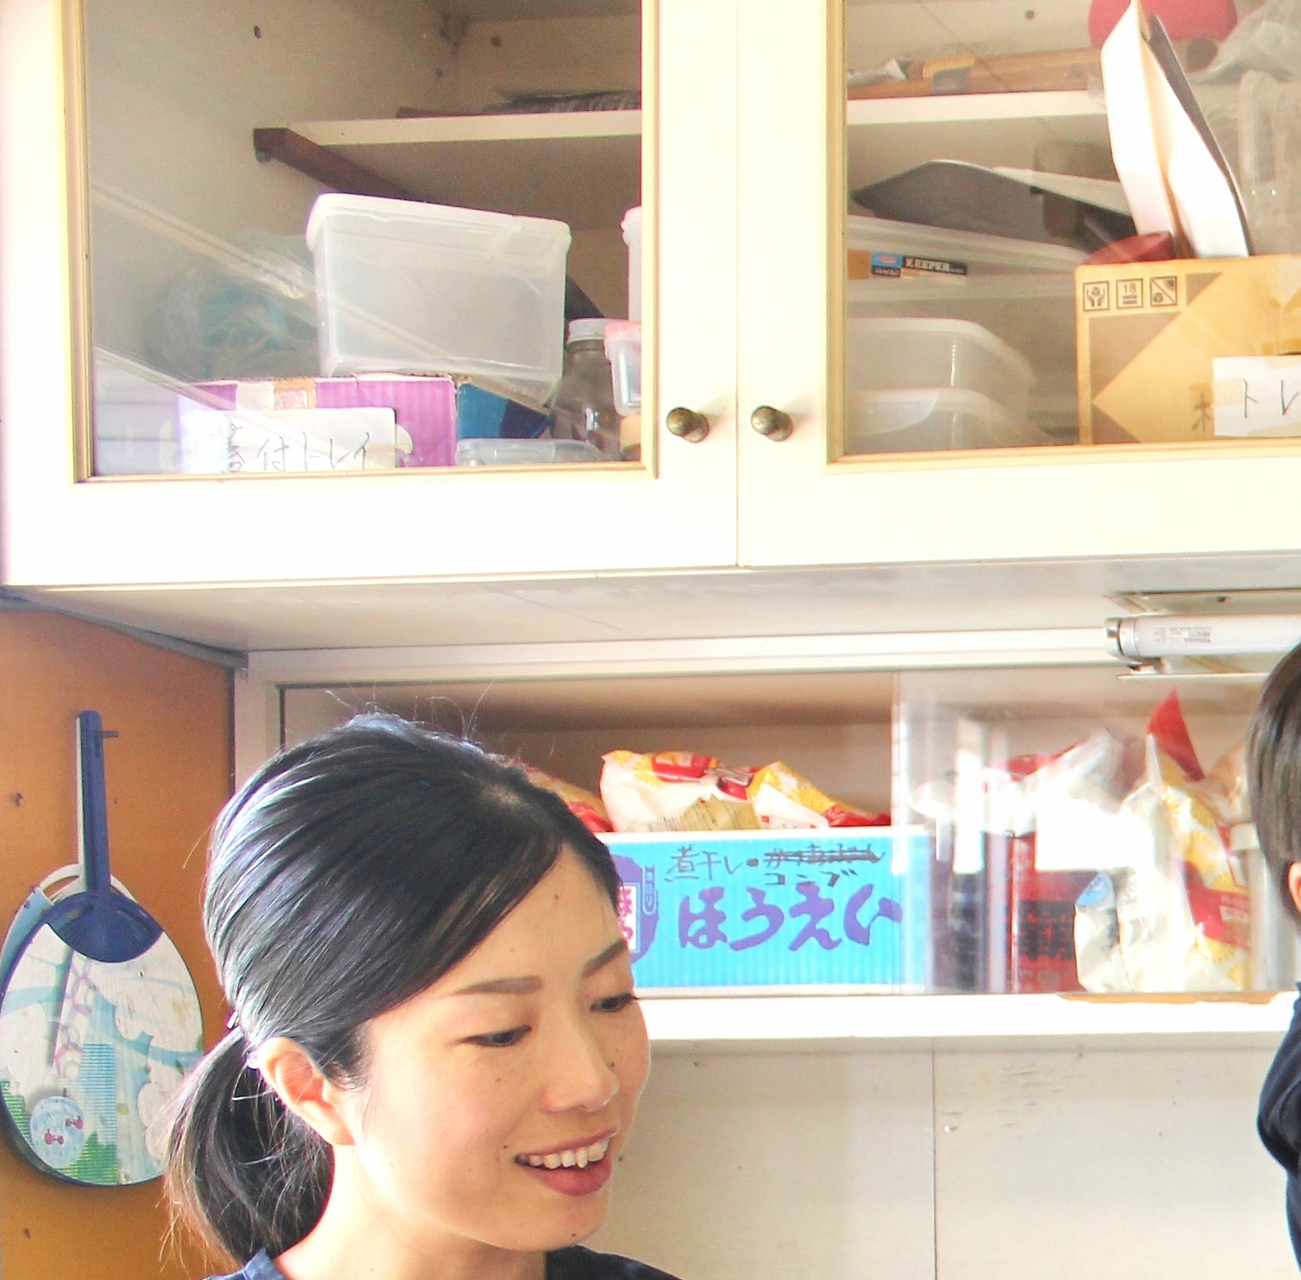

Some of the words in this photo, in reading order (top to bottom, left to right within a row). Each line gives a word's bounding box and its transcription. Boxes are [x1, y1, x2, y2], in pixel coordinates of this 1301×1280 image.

[1122, 281, 1137, 294] 18
[678, 883, 903, 952] ほうえい
